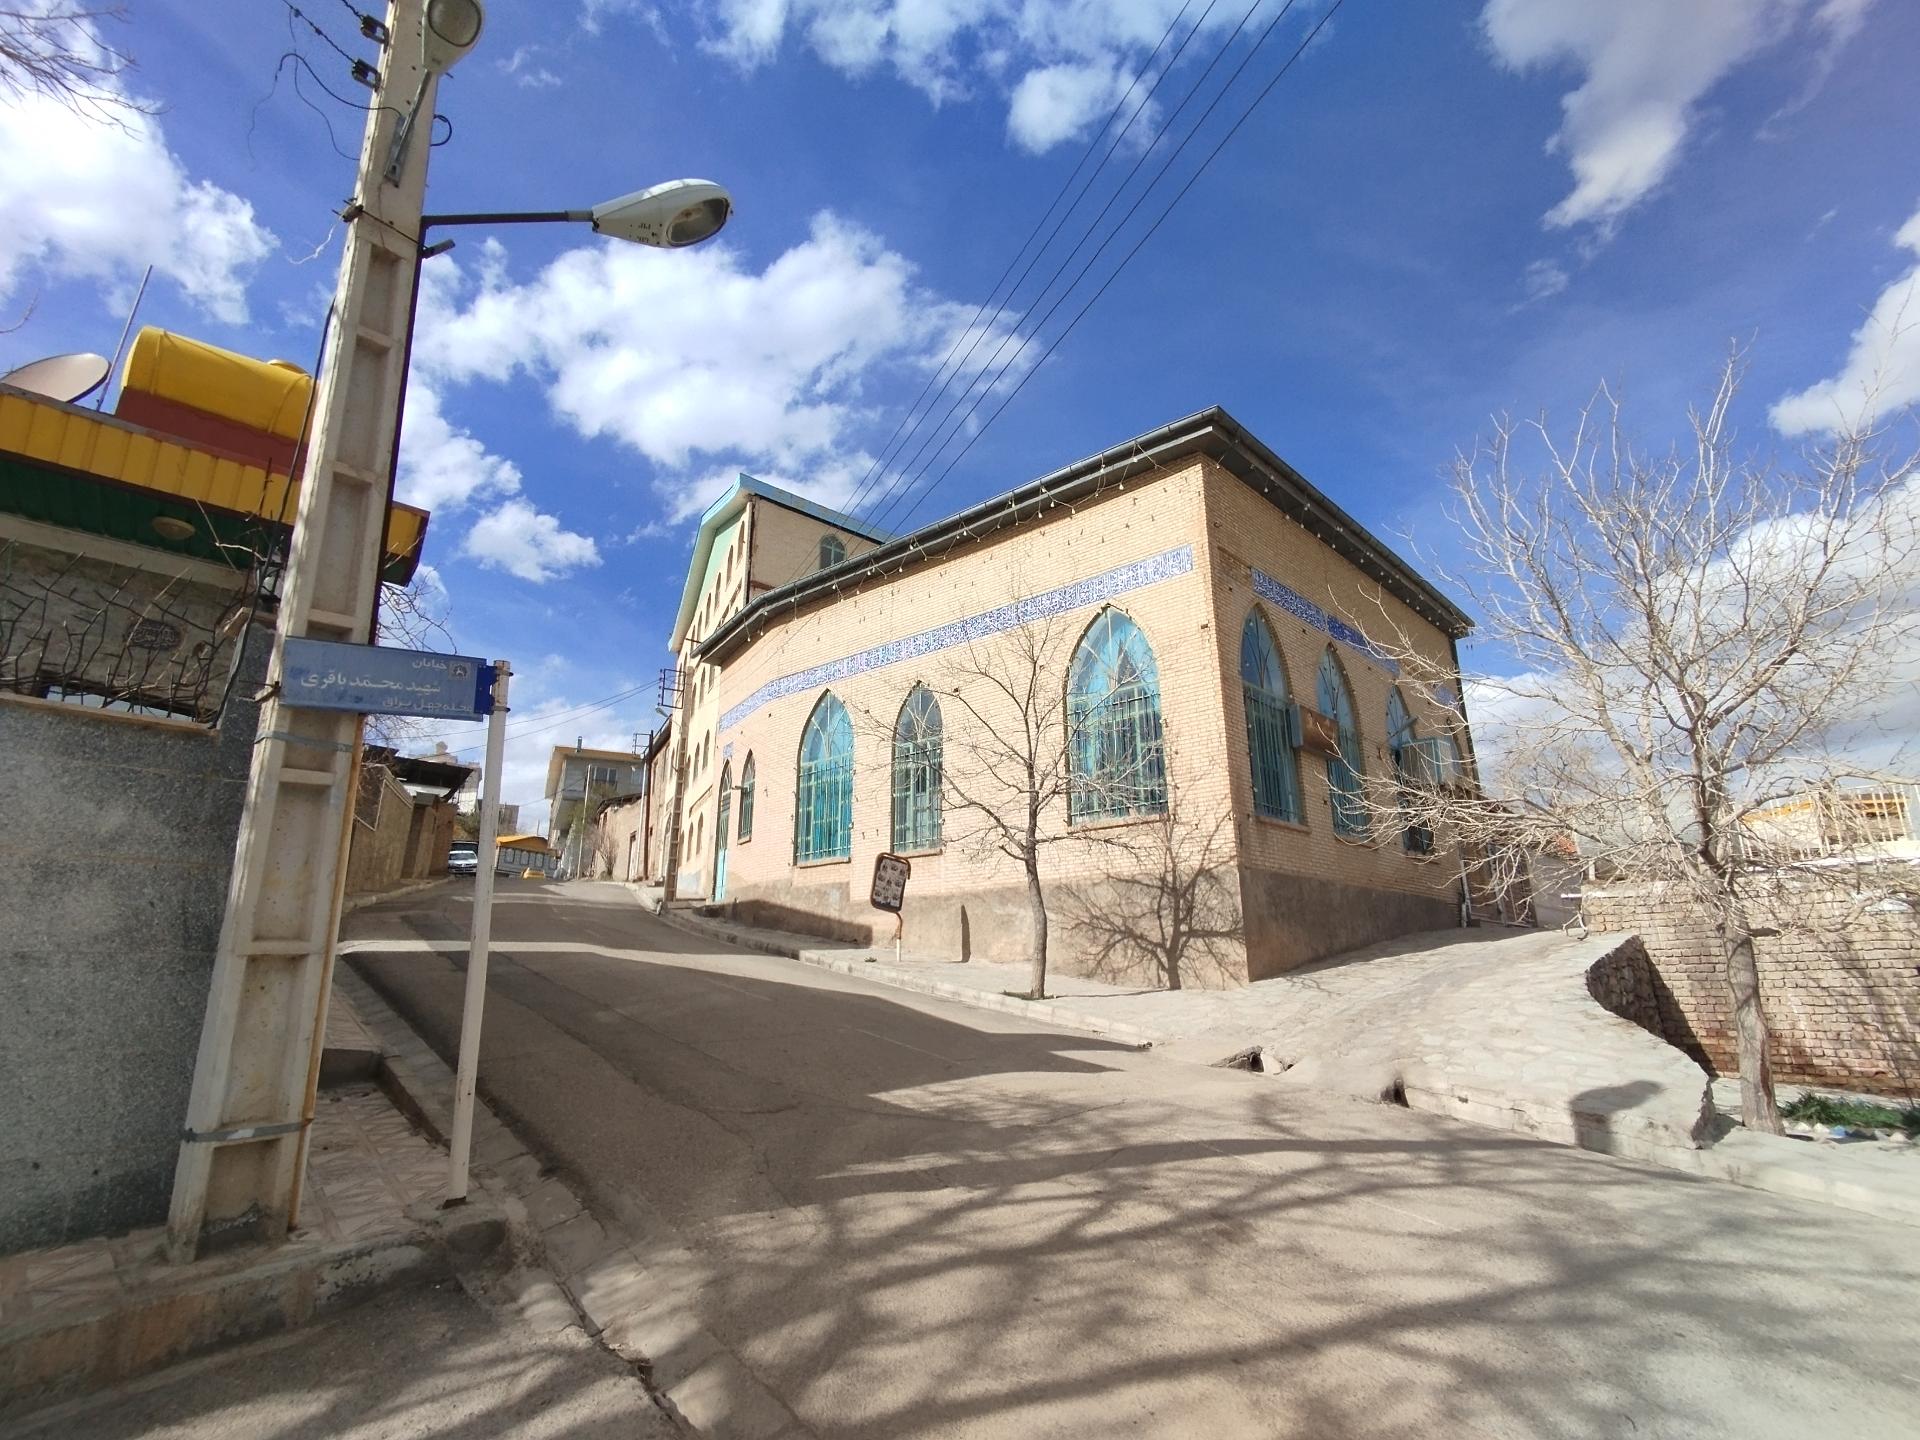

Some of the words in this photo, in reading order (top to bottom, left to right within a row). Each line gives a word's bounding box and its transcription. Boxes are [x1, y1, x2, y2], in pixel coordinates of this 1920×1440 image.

[412, 657, 447, 671] خیابان
[300, 668, 347, 690] باقری
[406, 682, 441, 696] شهید
